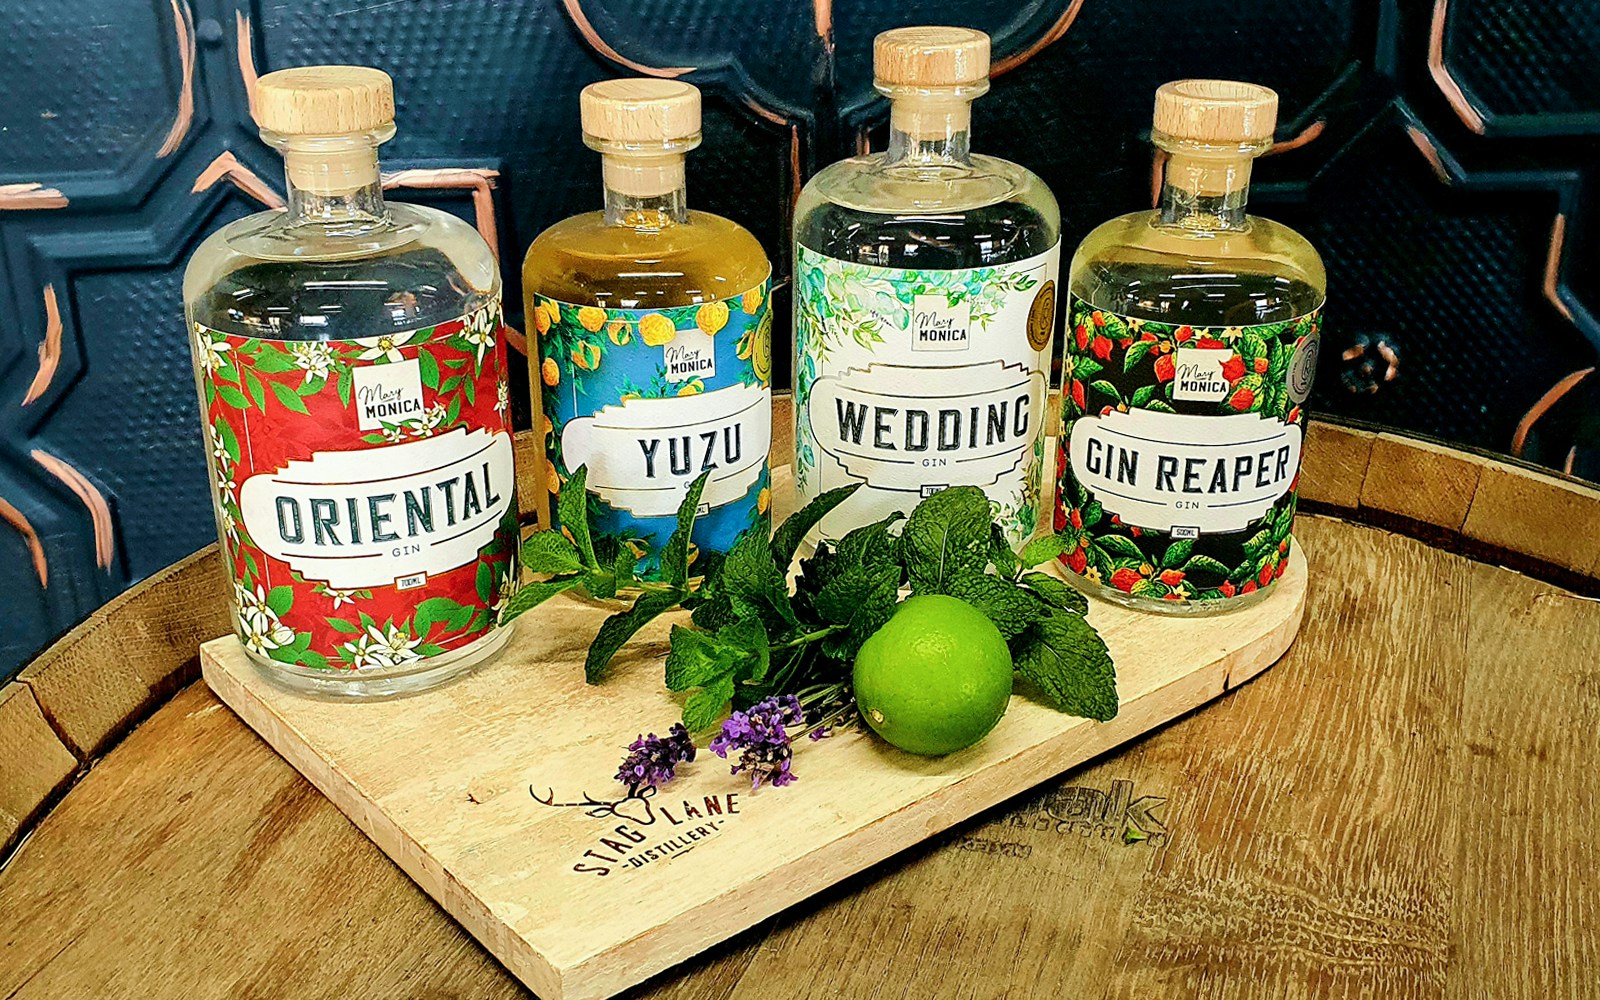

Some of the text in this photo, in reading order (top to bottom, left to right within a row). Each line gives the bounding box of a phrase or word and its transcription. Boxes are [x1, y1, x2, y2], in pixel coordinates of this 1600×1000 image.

[915, 311, 954, 328] Mary
[919, 329, 967, 342] MONICA
[666, 346, 702, 361] Mary
[671, 358, 713, 374] MONICA
[1177, 363, 1216, 380] Mary
[358, 383, 404, 402] Mary
[1180, 379, 1227, 393] MONICA
[365, 398, 421, 419] MONICA
[834, 394, 1031, 452] WEDDING
[637, 423, 742, 478] YUZU
[922, 458, 947, 467] GIN
[1086, 437, 1290, 494] GIN REAPER
[275, 462, 501, 546] ORIENTAL
[1175, 501, 1199, 509] GIN
[392, 544, 420, 557] GIN
[573, 793, 741, 877] STAG LANE
